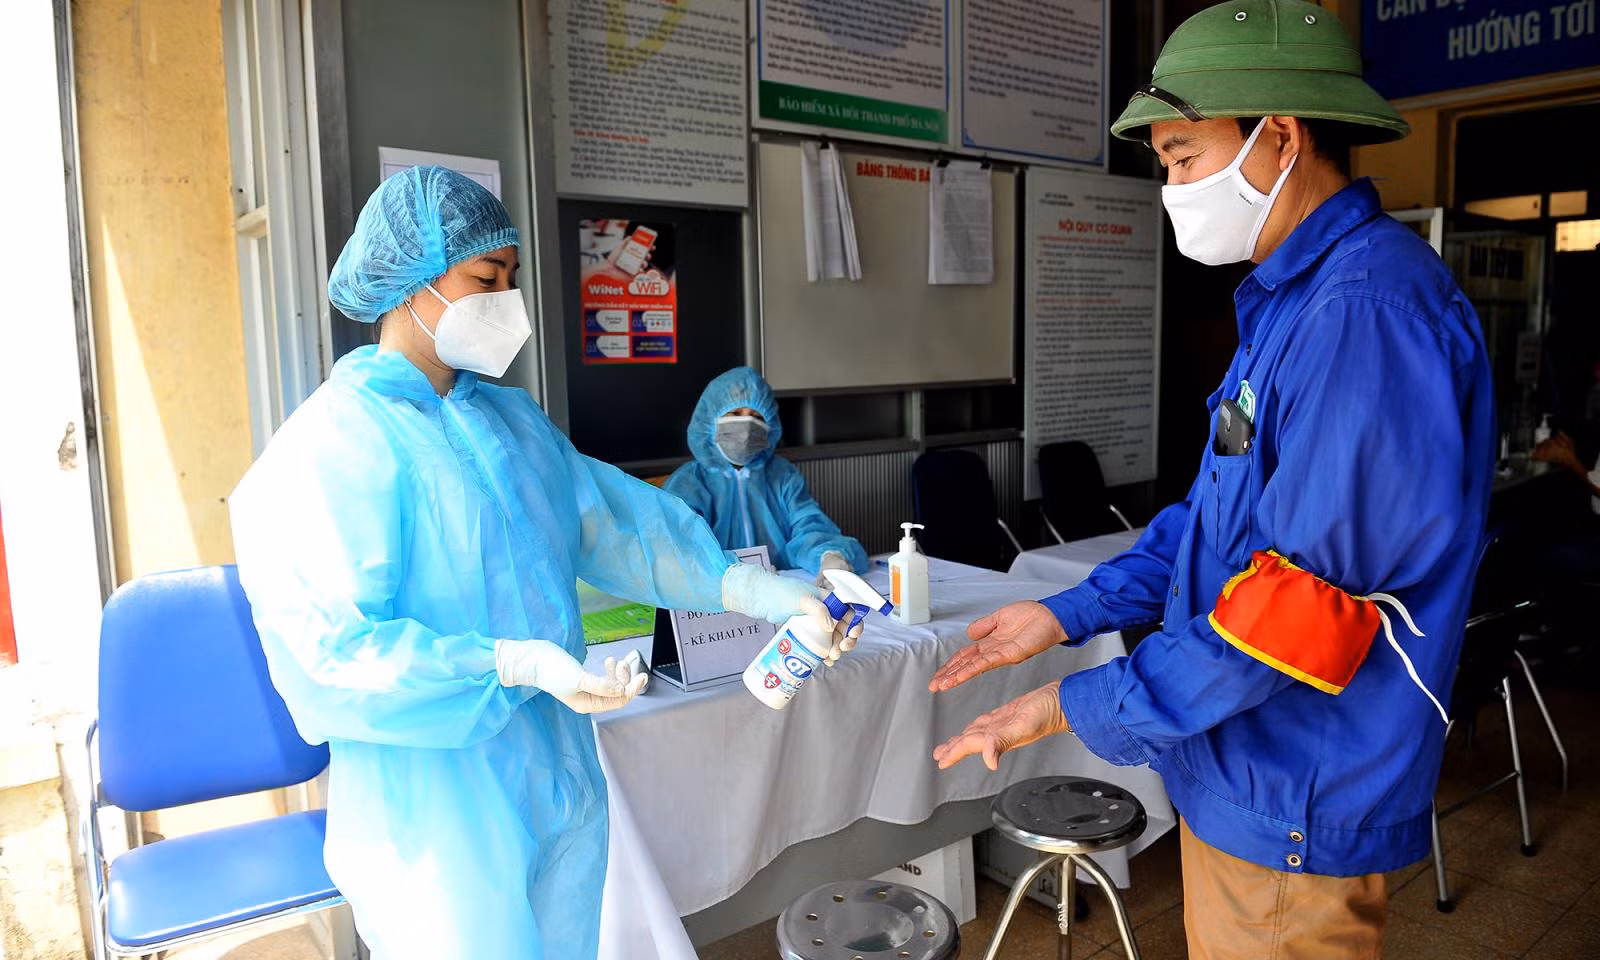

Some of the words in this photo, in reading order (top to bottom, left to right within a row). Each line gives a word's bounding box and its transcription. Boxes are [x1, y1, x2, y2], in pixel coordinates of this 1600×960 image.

[1447, 9, 1541, 61] HƯỚNG
[778, 96, 800, 111] BẢO
[800, 98, 826, 115] HIỂM
[842, 105, 859, 121] HỘI
[856, 160, 883, 178] BẢNG
[886, 164, 917, 182] THÔNG
[1059, 218, 1073, 232] NỘI
[1076, 220, 1093, 233] QUY
[1109, 223, 1132, 235] QUAN
[587, 284, 624, 296] WiNet
[636, 281, 662, 295] WiFi
[691, 632, 706, 646] KÊ
[708, 629, 736, 643] KHAI
[737, 627, 745, 637] Y
[746, 622, 761, 635] TẾ
